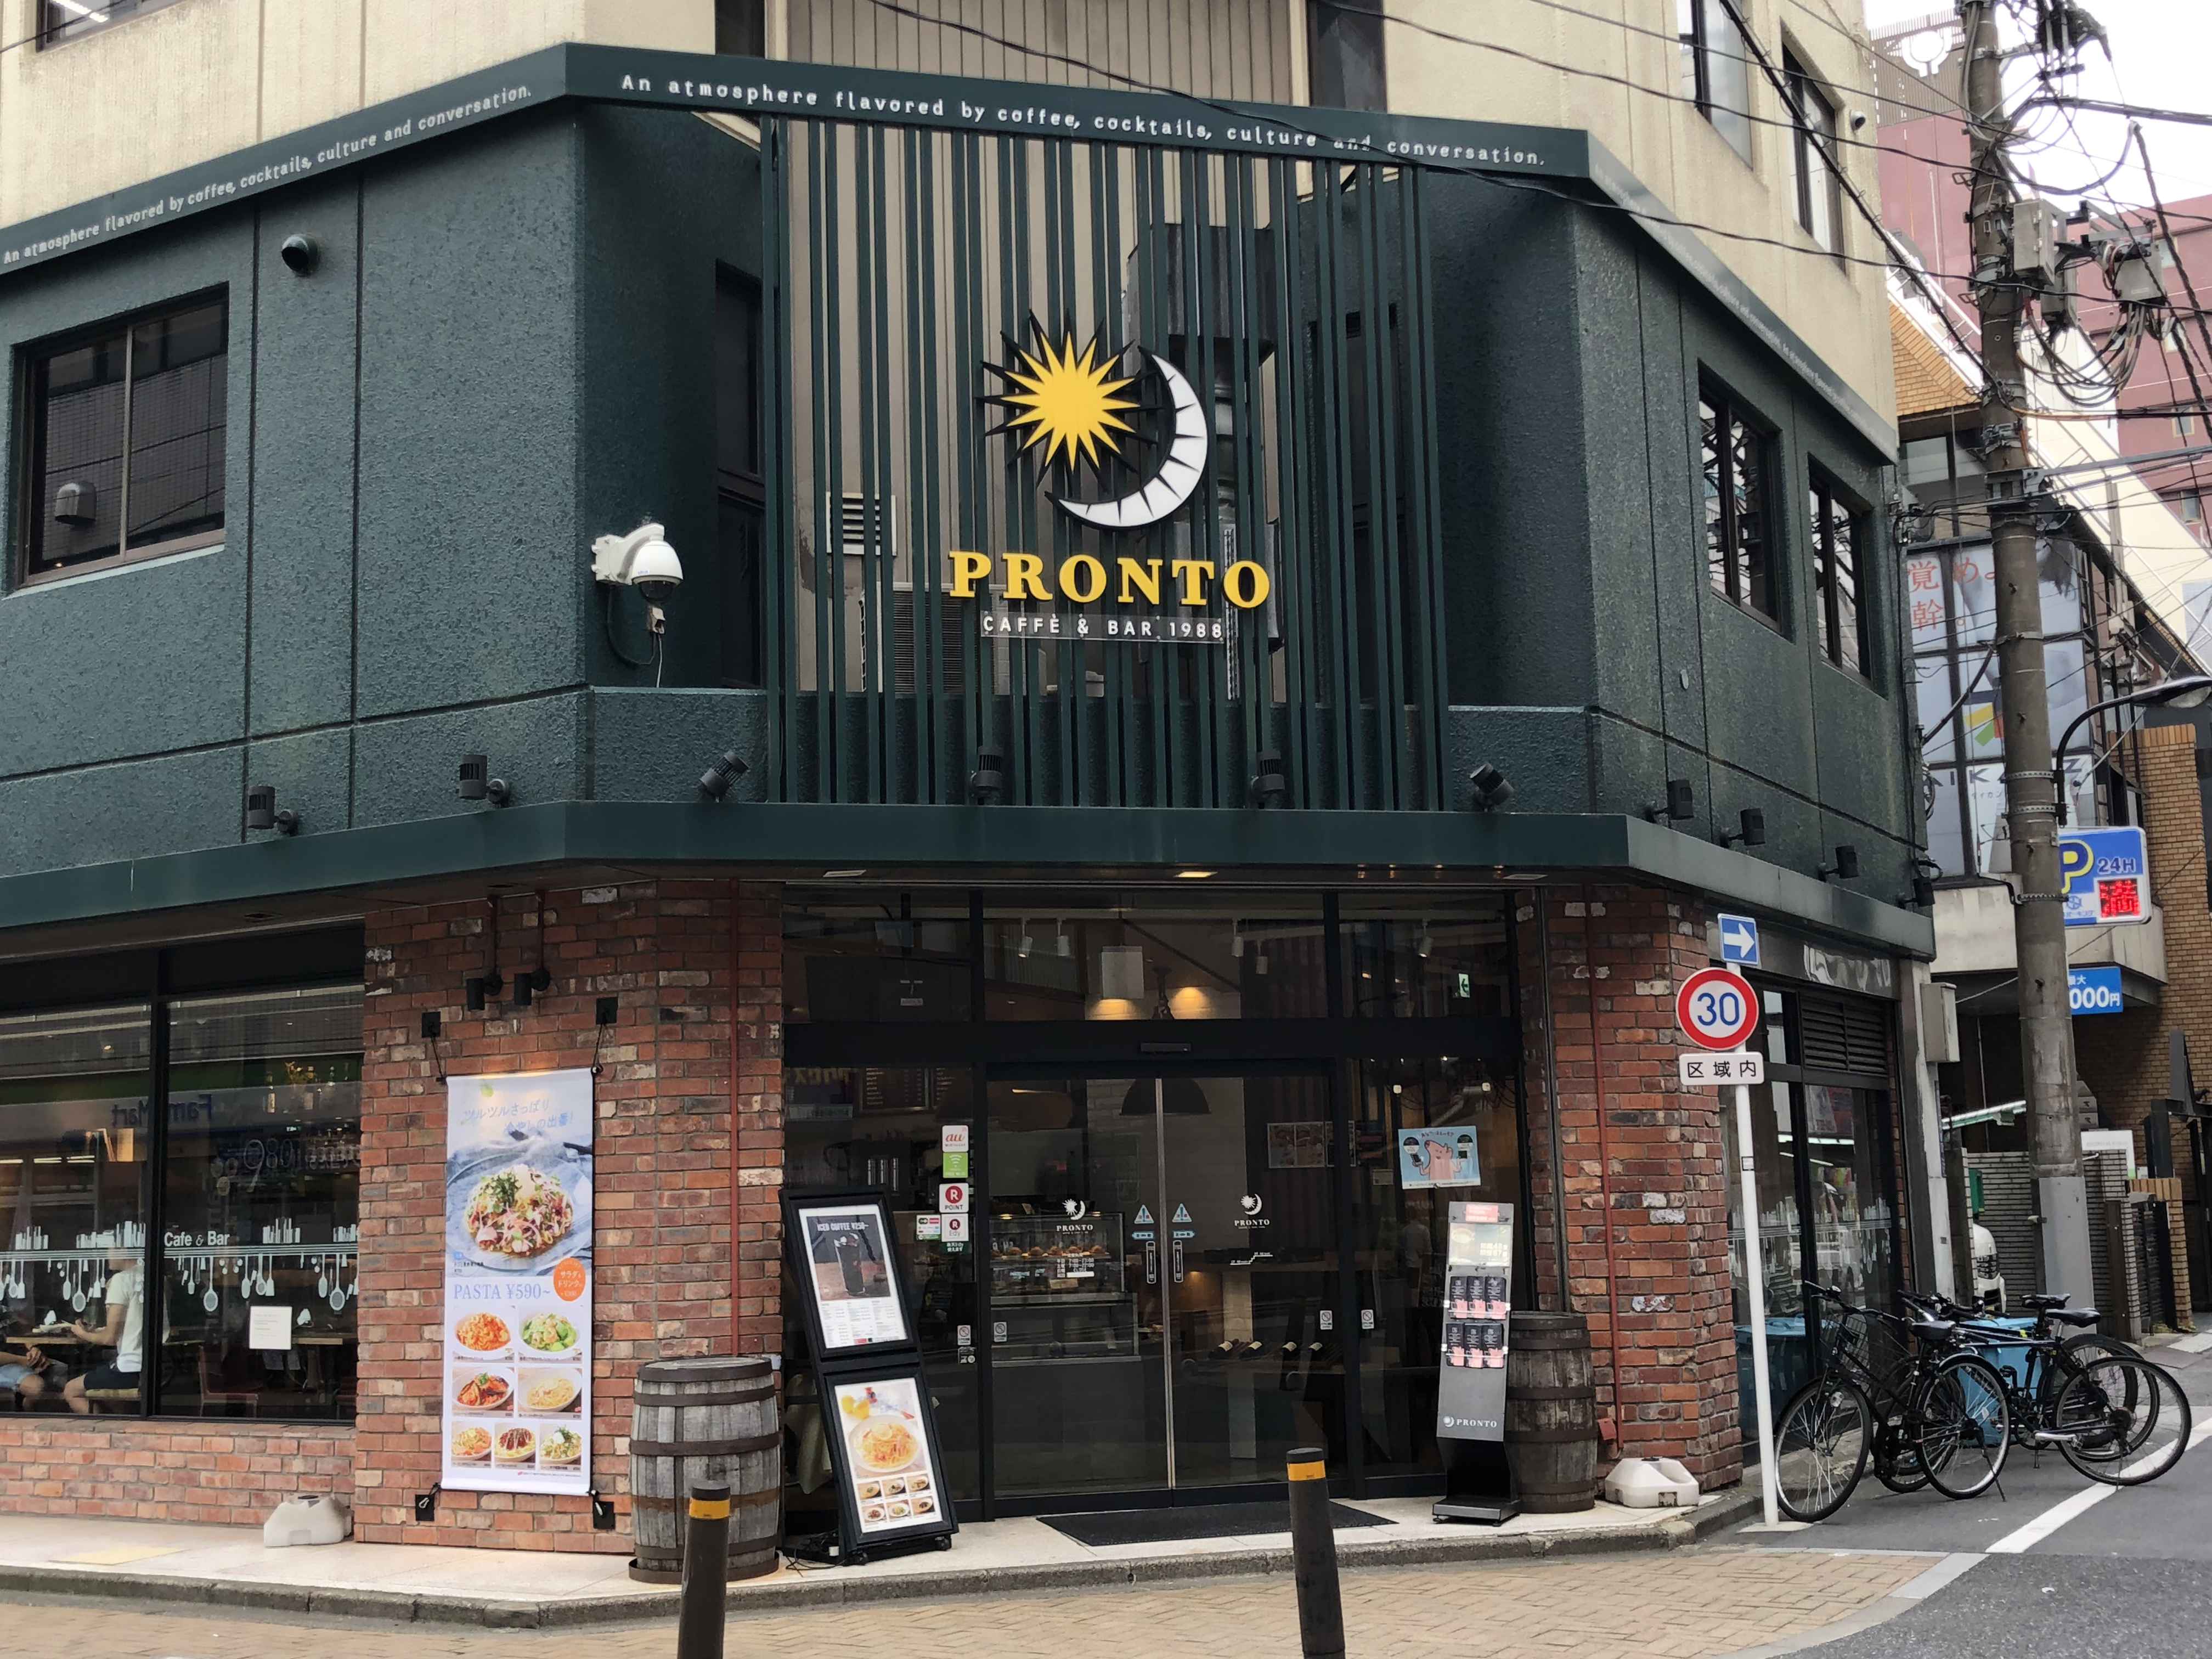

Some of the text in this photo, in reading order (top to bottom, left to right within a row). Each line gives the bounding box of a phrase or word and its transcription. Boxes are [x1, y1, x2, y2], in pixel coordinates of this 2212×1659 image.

[621, 74, 1545, 166] An atmosphere flavored by coffee, cocktails, culture and conversation.
[3, 85, 532, 264] An atmosphere flavored by coffee, cocktails, culture and conversation.
[949, 550, 1271, 608] PRONTO
[1908, 557, 1995, 592] 覚め
[983, 613, 1222, 638] CAFFÈ & BAR 1988
[2058, 839, 2095, 894] P
[2097, 856, 2136, 875] 24H
[2099, 879, 2141, 918] 満
[1697, 992, 1740, 1026] 30
[1687, 1059, 1756, 1078] 区域内
[945, 1133, 964, 1142] au
[164, 1231, 230, 1248] Cafe & Bar
[454, 1284, 503, 1300] PASTA
[1455, 1418, 1498, 1428] PRONTO
